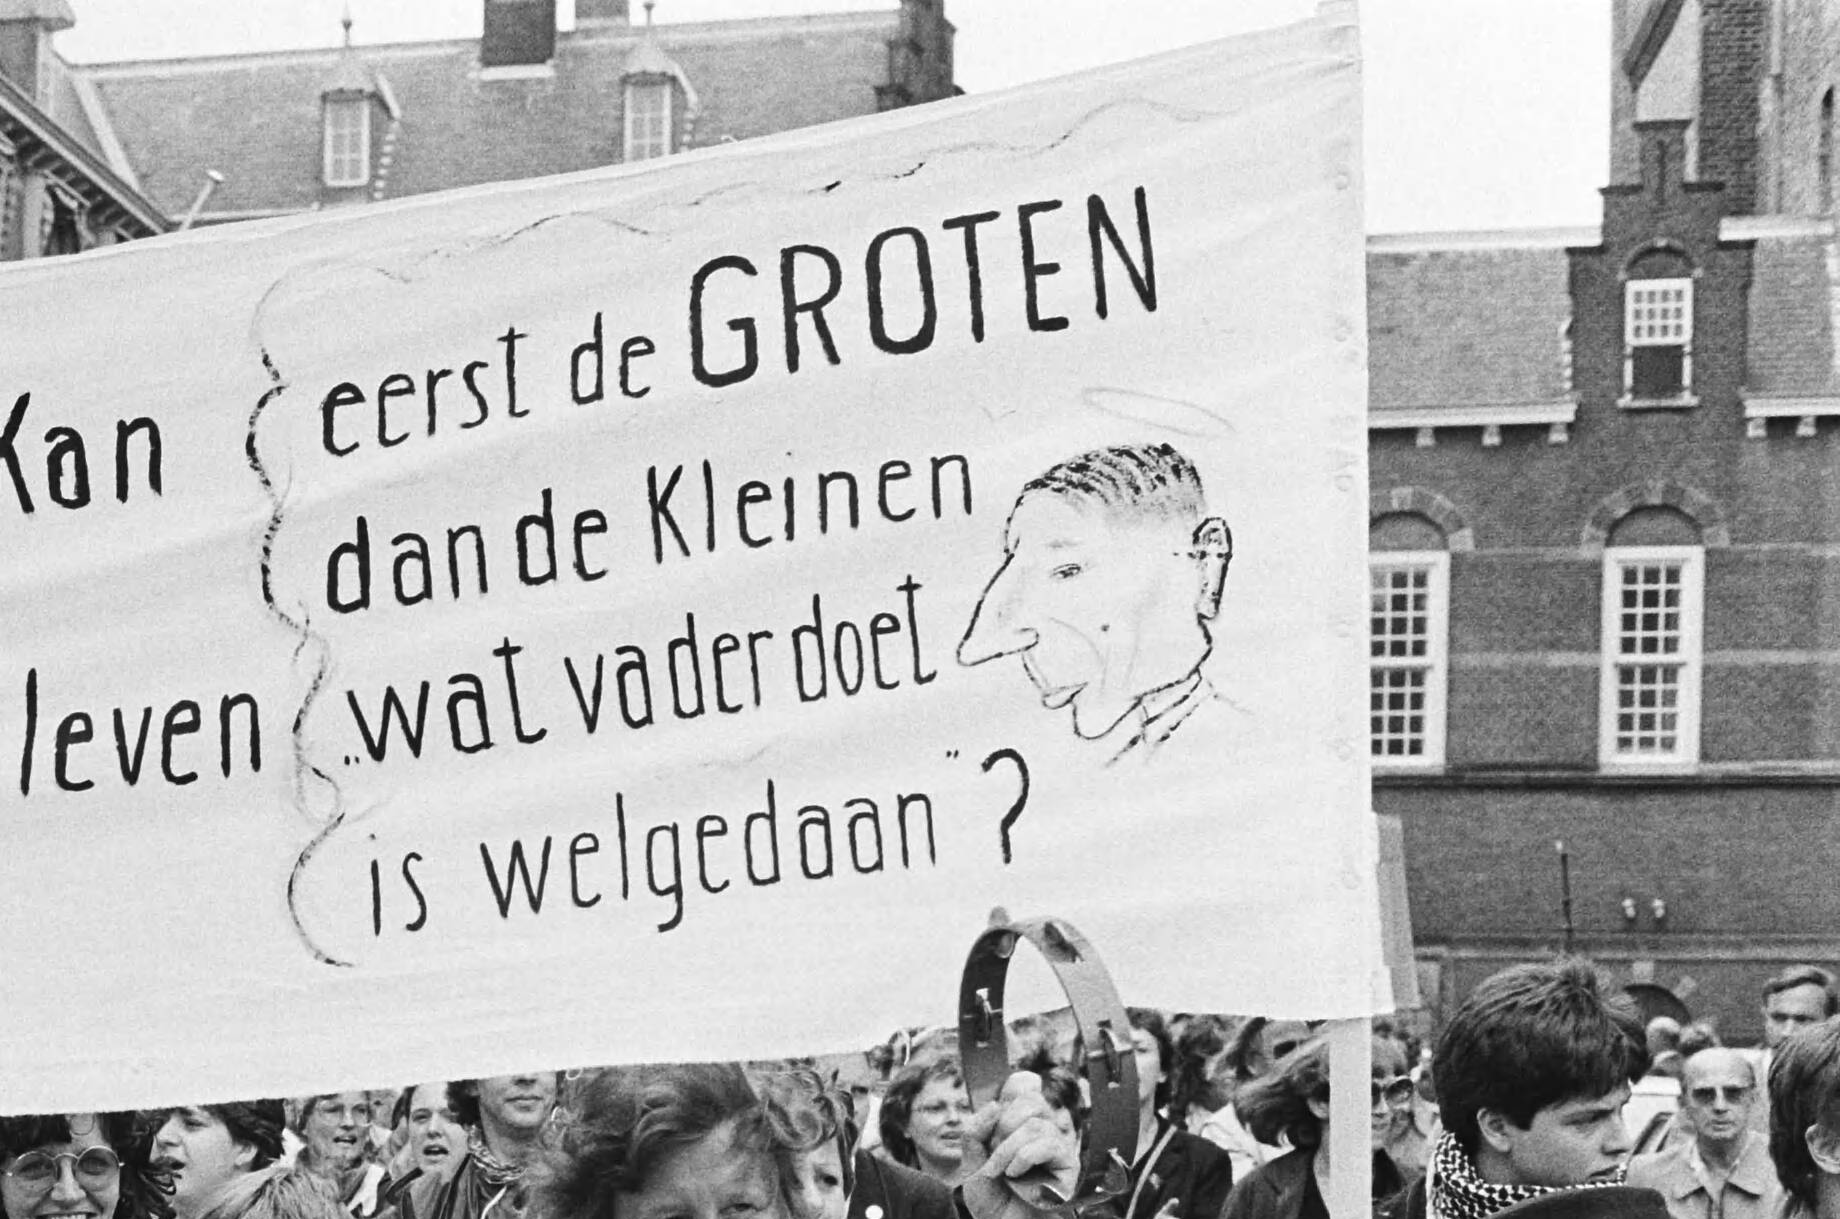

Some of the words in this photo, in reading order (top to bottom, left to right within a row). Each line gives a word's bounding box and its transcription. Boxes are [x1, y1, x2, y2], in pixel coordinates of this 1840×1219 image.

[321, 328, 530, 457] eerst
[570, 312, 656, 405] de
[689, 186, 1158, 388] GROTEN
[326, 515, 489, 614] dan
[515, 488, 609, 586] de
[647, 450, 973, 564] Kleinen
[20, 668, 261, 797] leven
[564, 613, 774, 734] vader
[791, 574, 938, 702] doet
[369, 833, 428, 936] is
